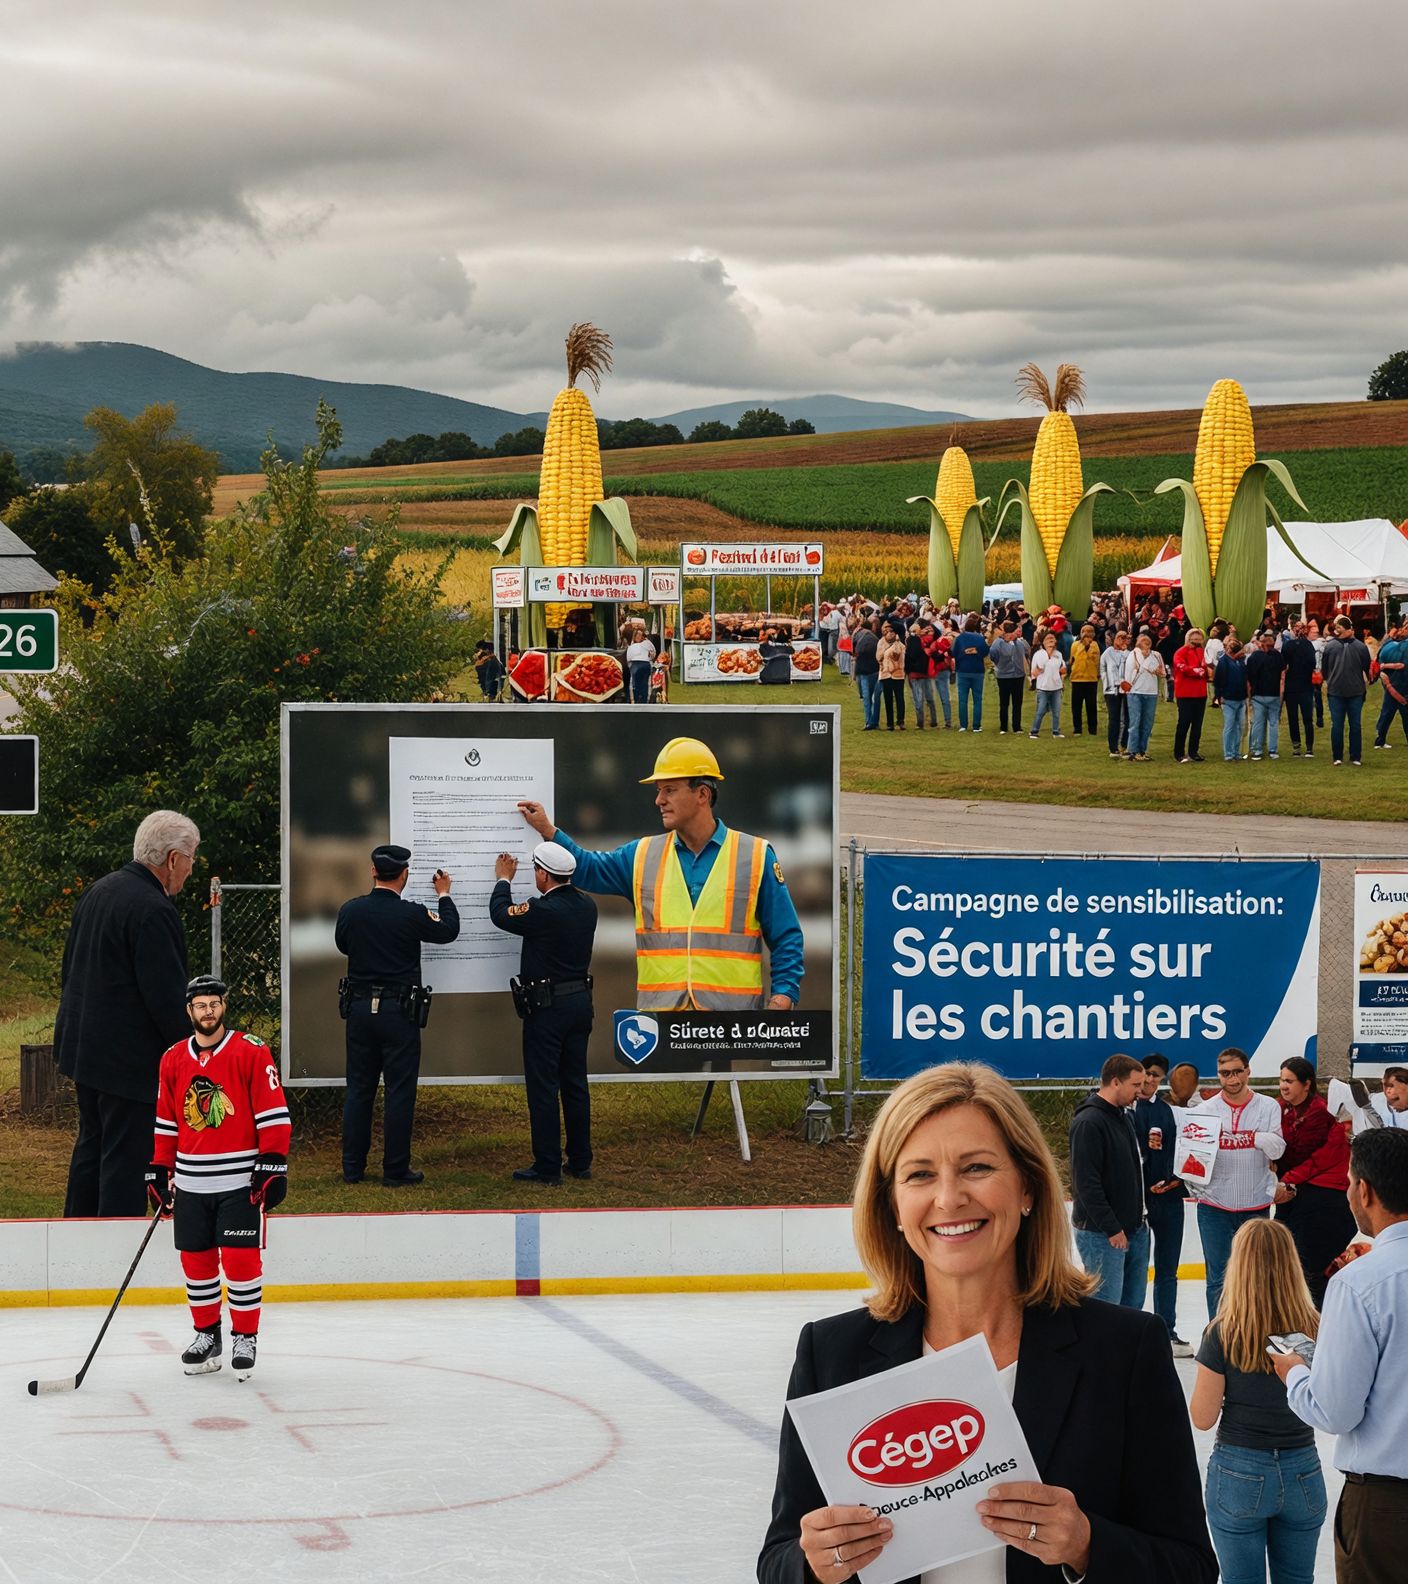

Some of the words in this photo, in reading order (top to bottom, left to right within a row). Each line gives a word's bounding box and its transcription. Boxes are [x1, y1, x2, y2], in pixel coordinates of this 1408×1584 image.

[892, 885, 1039, 918] Campagne
[1047, 888, 1079, 913] de
[1087, 889, 1284, 915] sensibilisation:
[892, 927, 1115, 978] Sécurité
[1130, 943, 1212, 978] sur
[892, 990, 966, 1040] les
[981, 990, 1227, 1040] chantiers
[851, 1414, 980, 1475] Cégep
